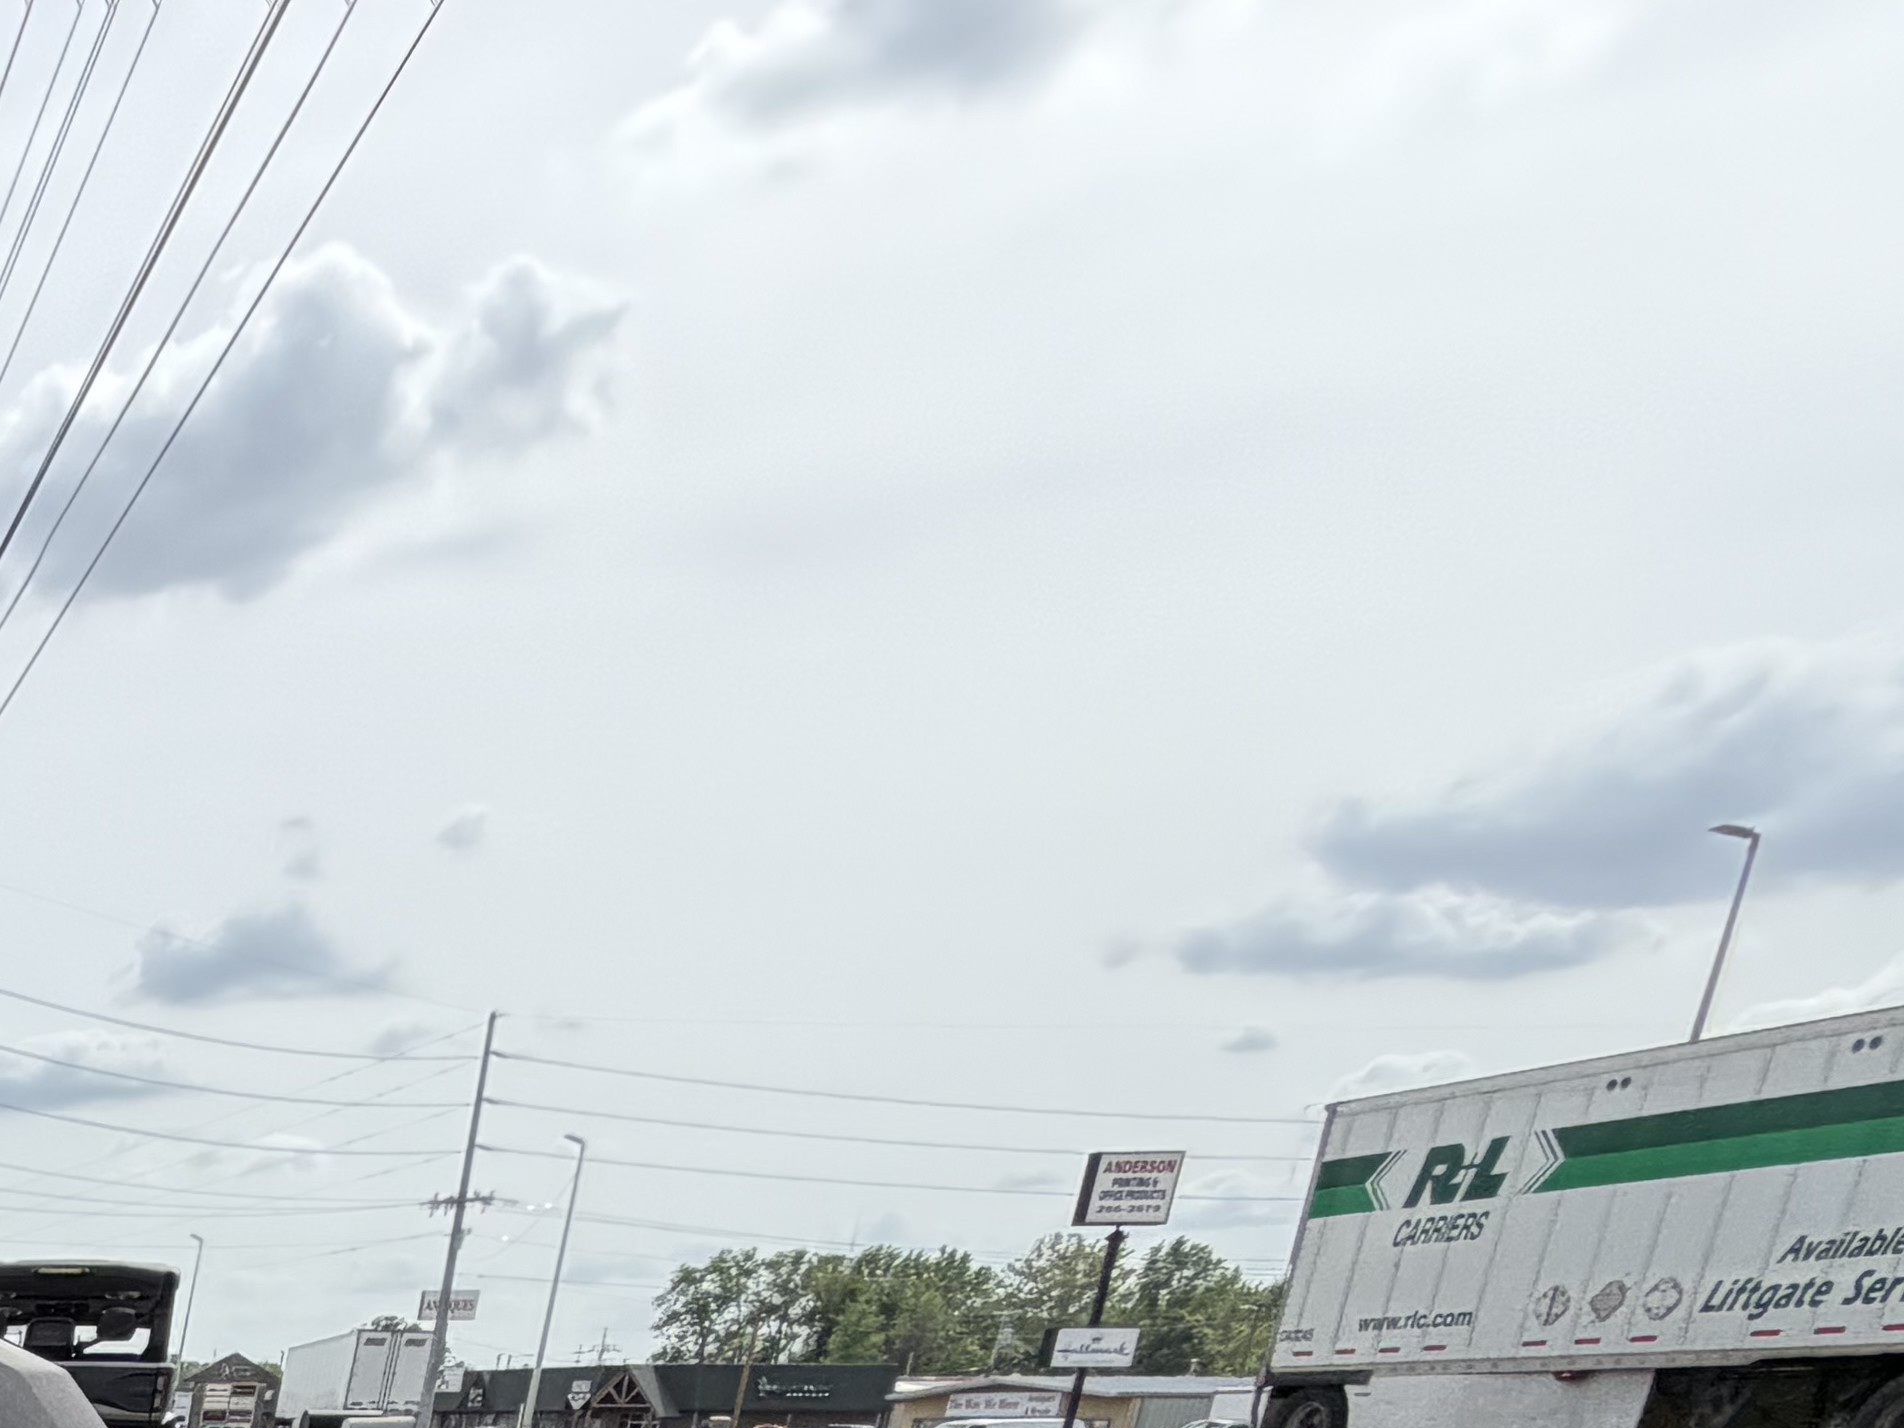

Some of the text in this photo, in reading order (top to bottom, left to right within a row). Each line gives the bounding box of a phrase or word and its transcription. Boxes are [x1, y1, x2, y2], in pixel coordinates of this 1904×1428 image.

[1103, 1159, 1178, 1174] ANDERSON
[1392, 1211, 1490, 1248] CARRIERS
[1698, 1269, 1904, 1320] Liftgate Ser
[1358, 1310, 1473, 1332] www.rlc.com
